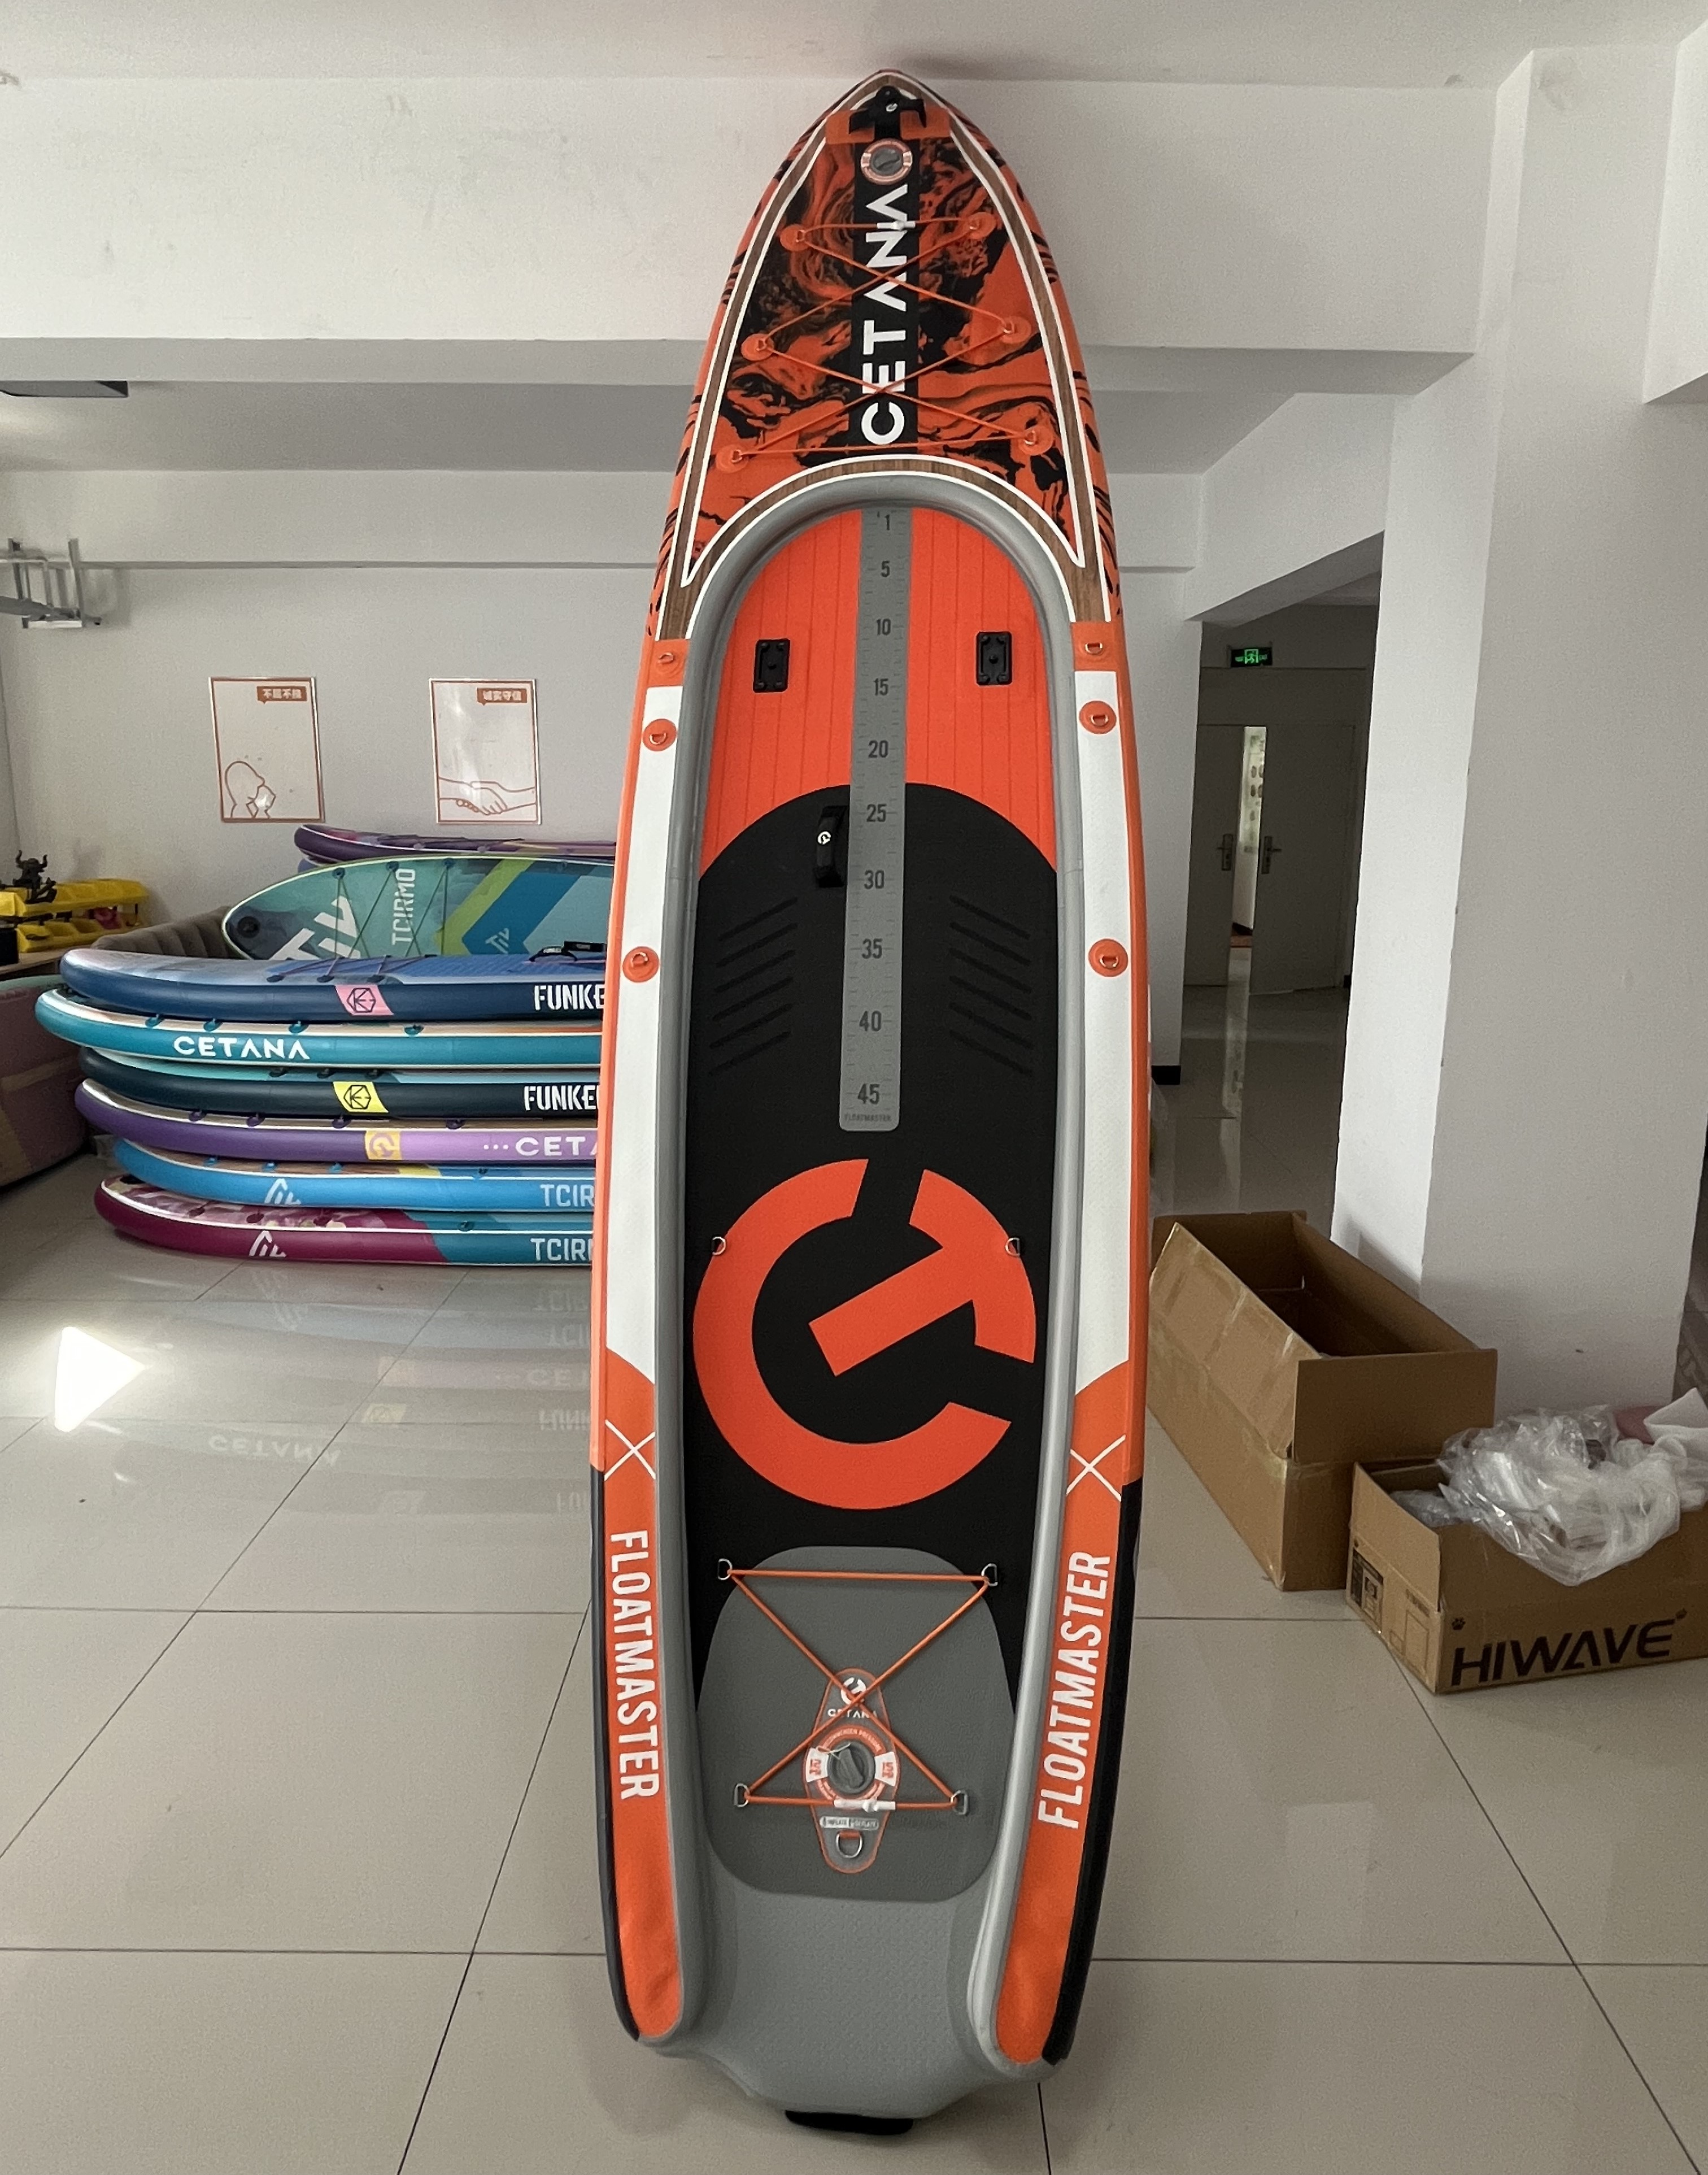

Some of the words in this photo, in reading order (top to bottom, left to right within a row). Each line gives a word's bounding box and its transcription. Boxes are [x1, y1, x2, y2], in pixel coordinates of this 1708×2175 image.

[861, 184, 908, 445] CETANA
[884, 514, 891, 531] 1
[881, 560, 891, 577] 5
[876, 618, 891, 636] 10
[873, 677, 889, 696] 15
[868, 740, 889, 758] 20
[866, 803, 887, 823] 25
[864, 870, 885, 889] 30
[391, 869, 416, 946] TCIRMO
[861, 938, 883, 960] 35
[859, 1010, 882, 1032] 40
[174, 1036, 310, 1060] CETANA
[524, 1085, 599, 1111] FUNKE
[857, 1083, 881, 1105] 45
[530, 1238, 593, 1261] TCIR
[1451, 1617, 1676, 1686] HIWAVE
[610, 1529, 660, 1800] FLOATMASTER
[1038, 1551, 1110, 1829] FLOATMASTER
